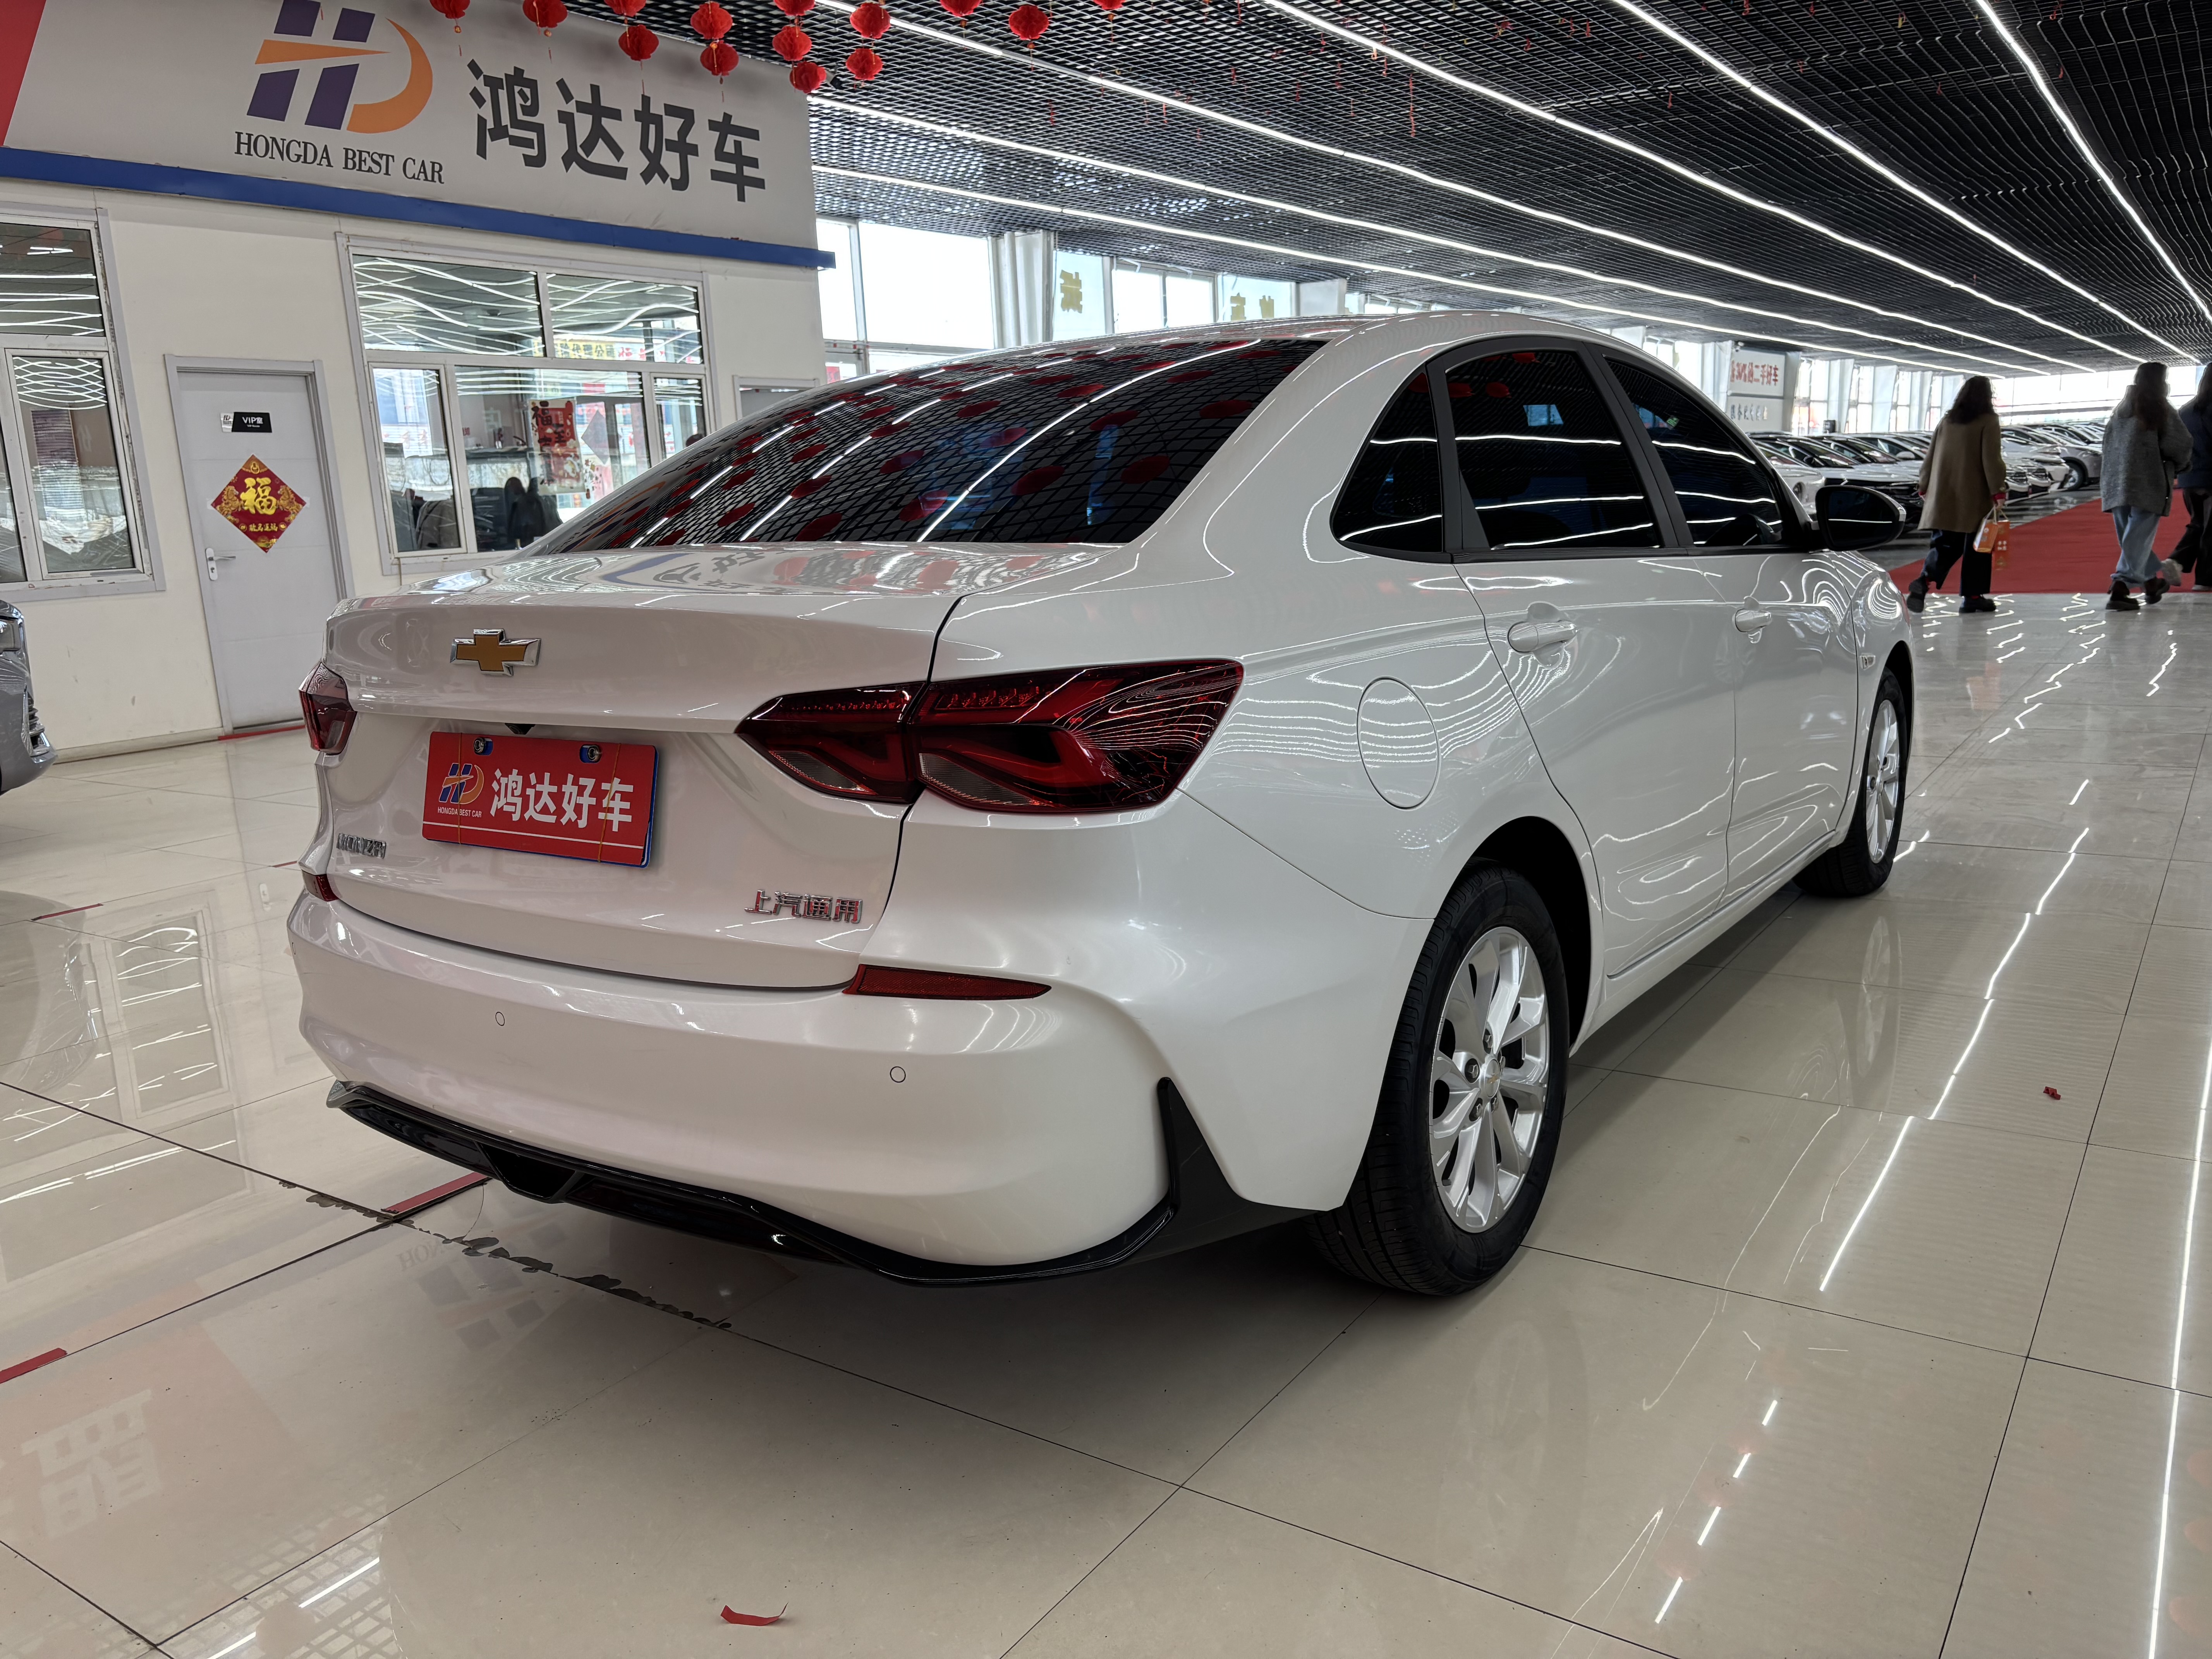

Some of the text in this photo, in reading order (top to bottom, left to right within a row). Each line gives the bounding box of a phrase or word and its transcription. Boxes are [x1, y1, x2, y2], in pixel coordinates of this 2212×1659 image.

[467, 59, 766, 202] 鸿达好车
[235, 131, 445, 184] HONGDA BEST CAR
[240, 477, 276, 515] 福
[438, 806, 458, 815] HONGDA
[459, 809, 471, 817] BEST
[490, 768, 634, 832] 鸿达好车
[744, 890, 863, 924] 上汽通用
